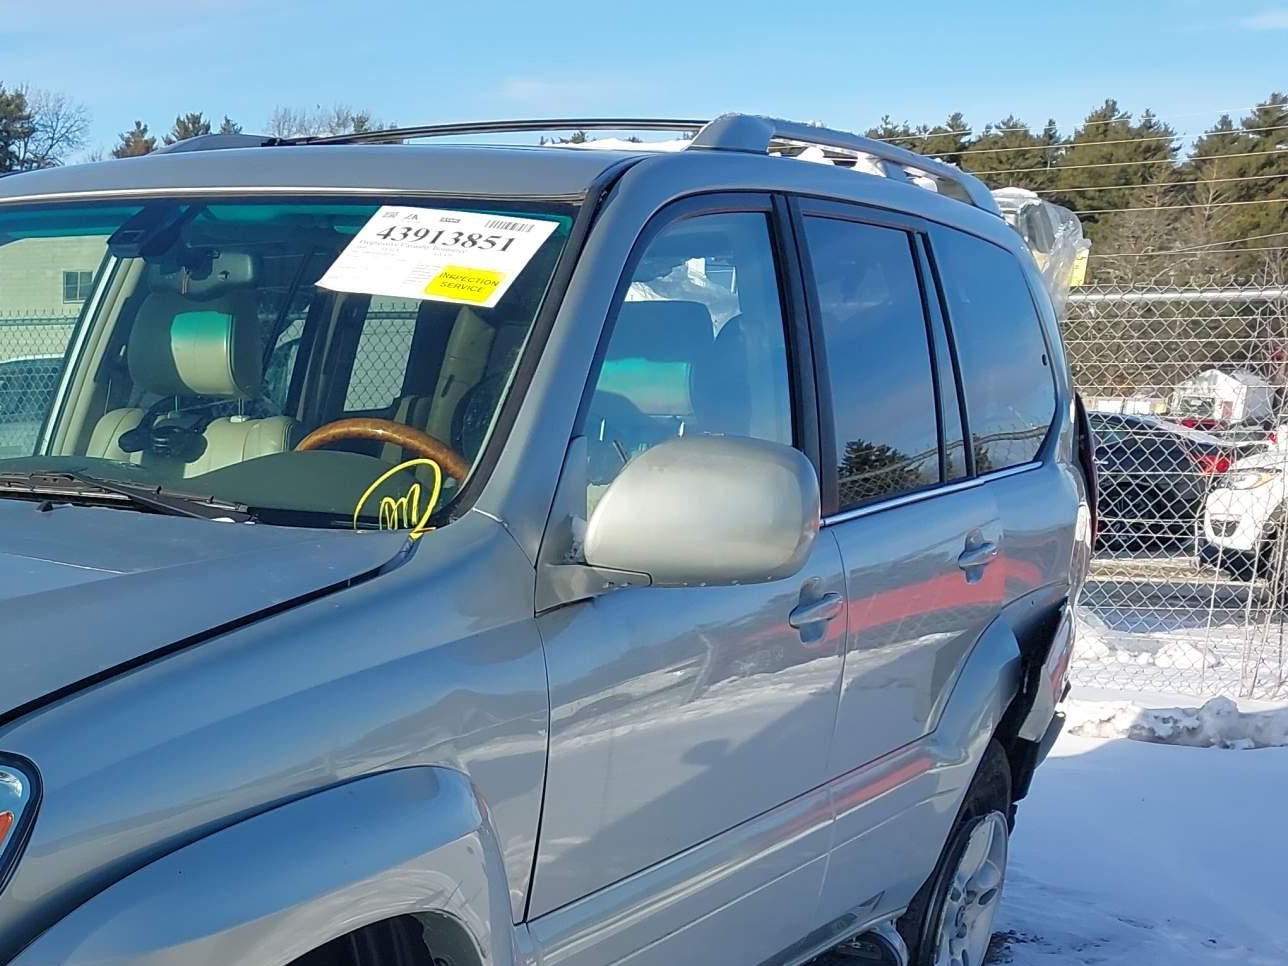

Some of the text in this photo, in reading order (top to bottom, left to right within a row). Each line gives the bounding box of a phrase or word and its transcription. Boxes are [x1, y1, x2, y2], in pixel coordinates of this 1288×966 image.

[376, 225, 515, 252] 43913851
[439, 271, 500, 287] INSPECTION
[439, 281, 484, 293] SERVICE
